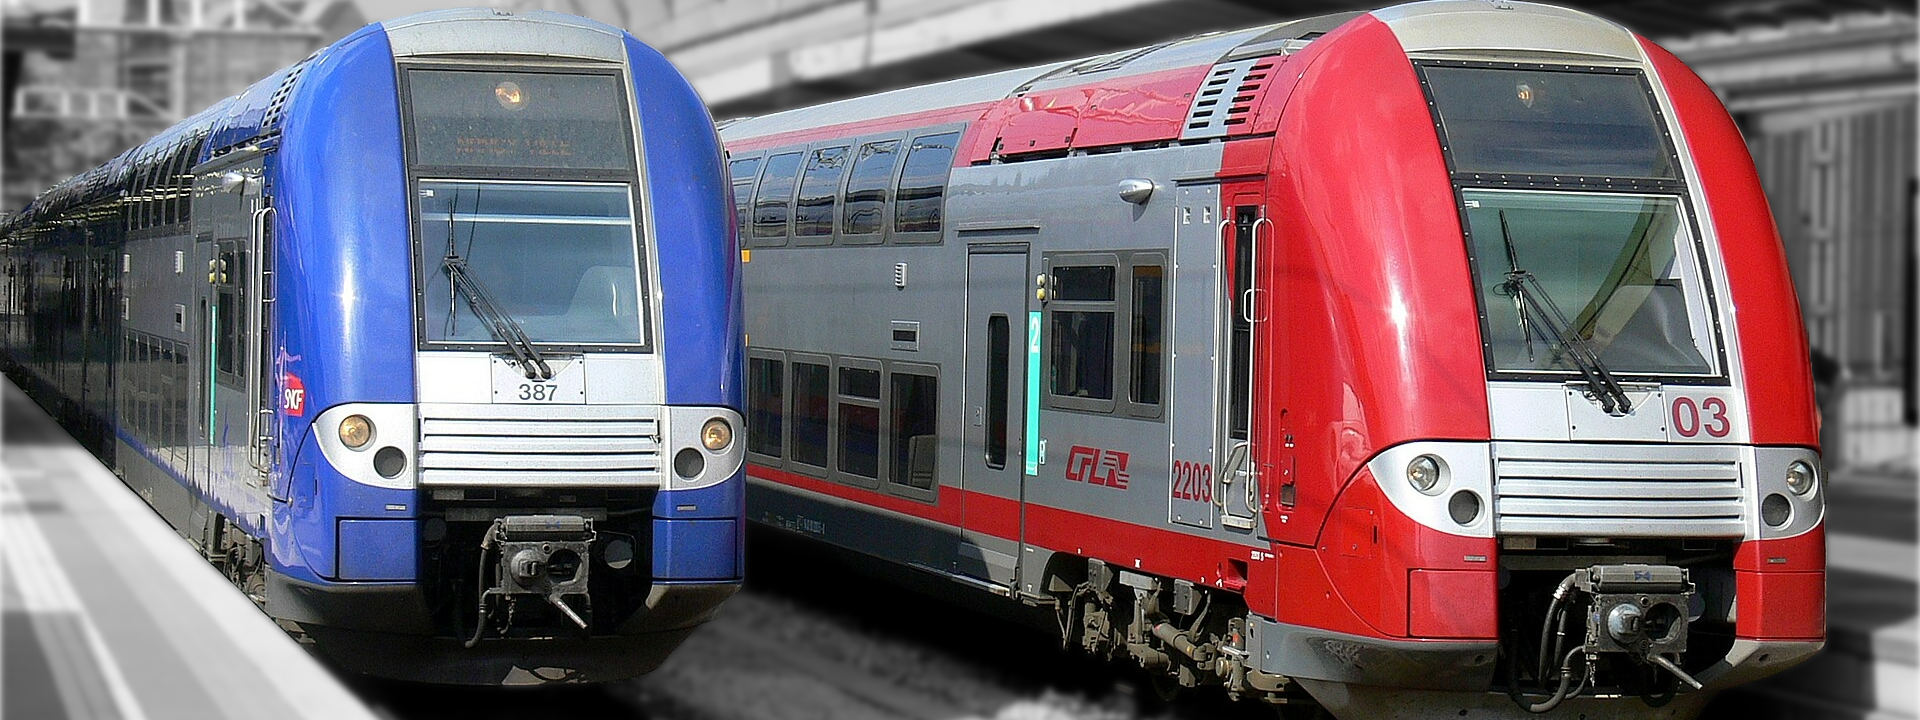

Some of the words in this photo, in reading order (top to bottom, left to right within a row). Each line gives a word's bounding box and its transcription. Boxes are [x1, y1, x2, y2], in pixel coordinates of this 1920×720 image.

[1030, 315, 1041, 354] 2
[283, 388, 304, 411] SNCF
[518, 384, 558, 401] 387
[1671, 396, 1731, 438] 03
[1065, 445, 1108, 487] CFL
[1173, 460, 1211, 503] 2203
